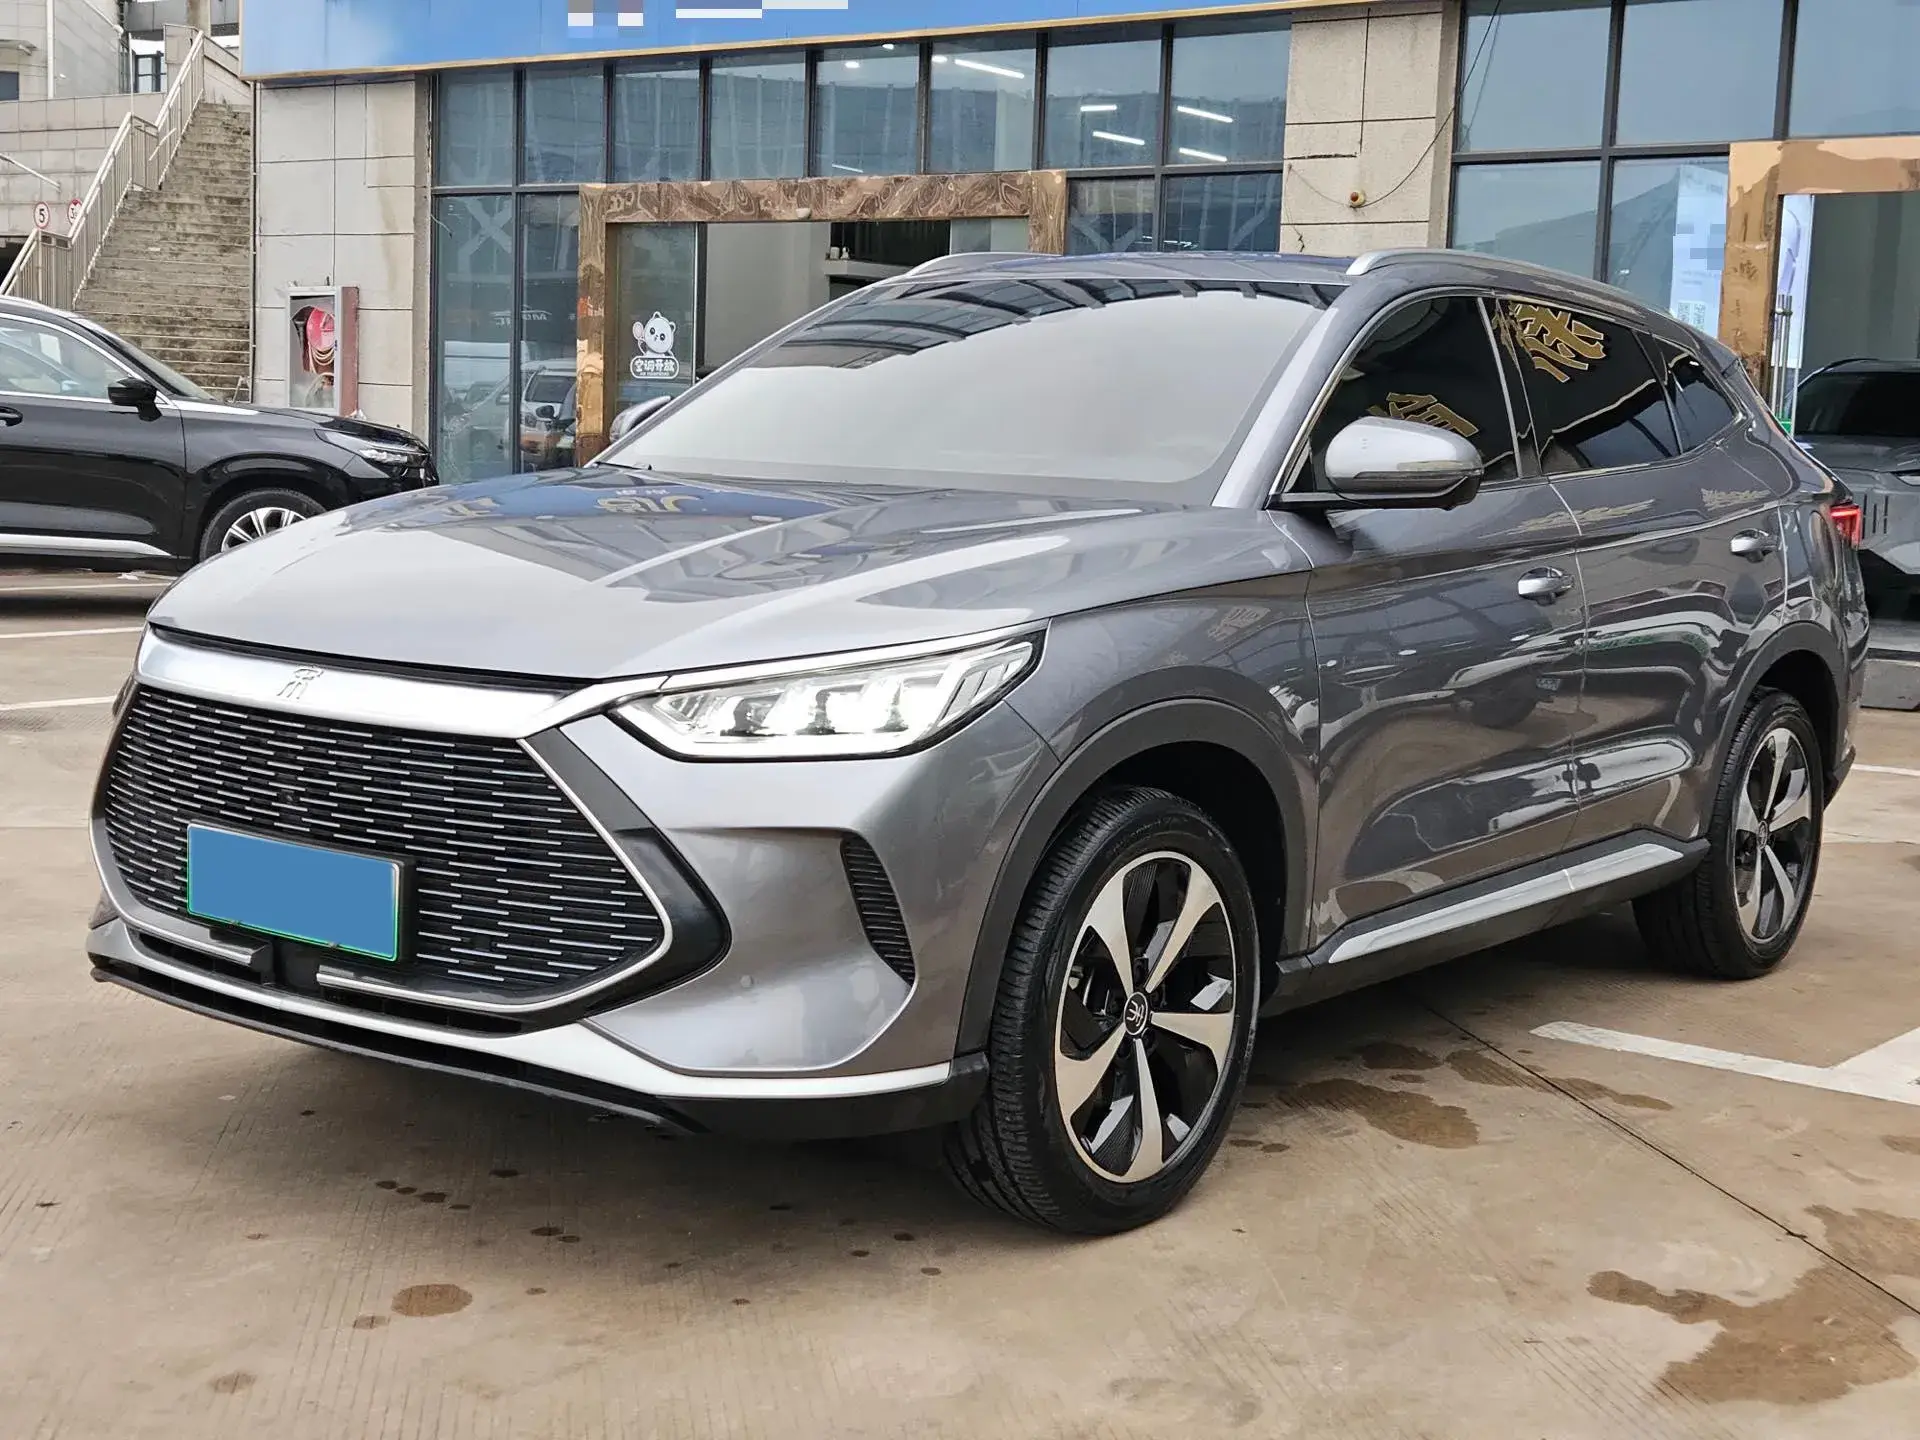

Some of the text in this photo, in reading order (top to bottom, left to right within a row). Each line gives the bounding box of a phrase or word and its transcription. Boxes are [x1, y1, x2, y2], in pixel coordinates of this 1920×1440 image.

[39, 208, 45, 223] 5
[634, 359, 675, 373] 空调开放
